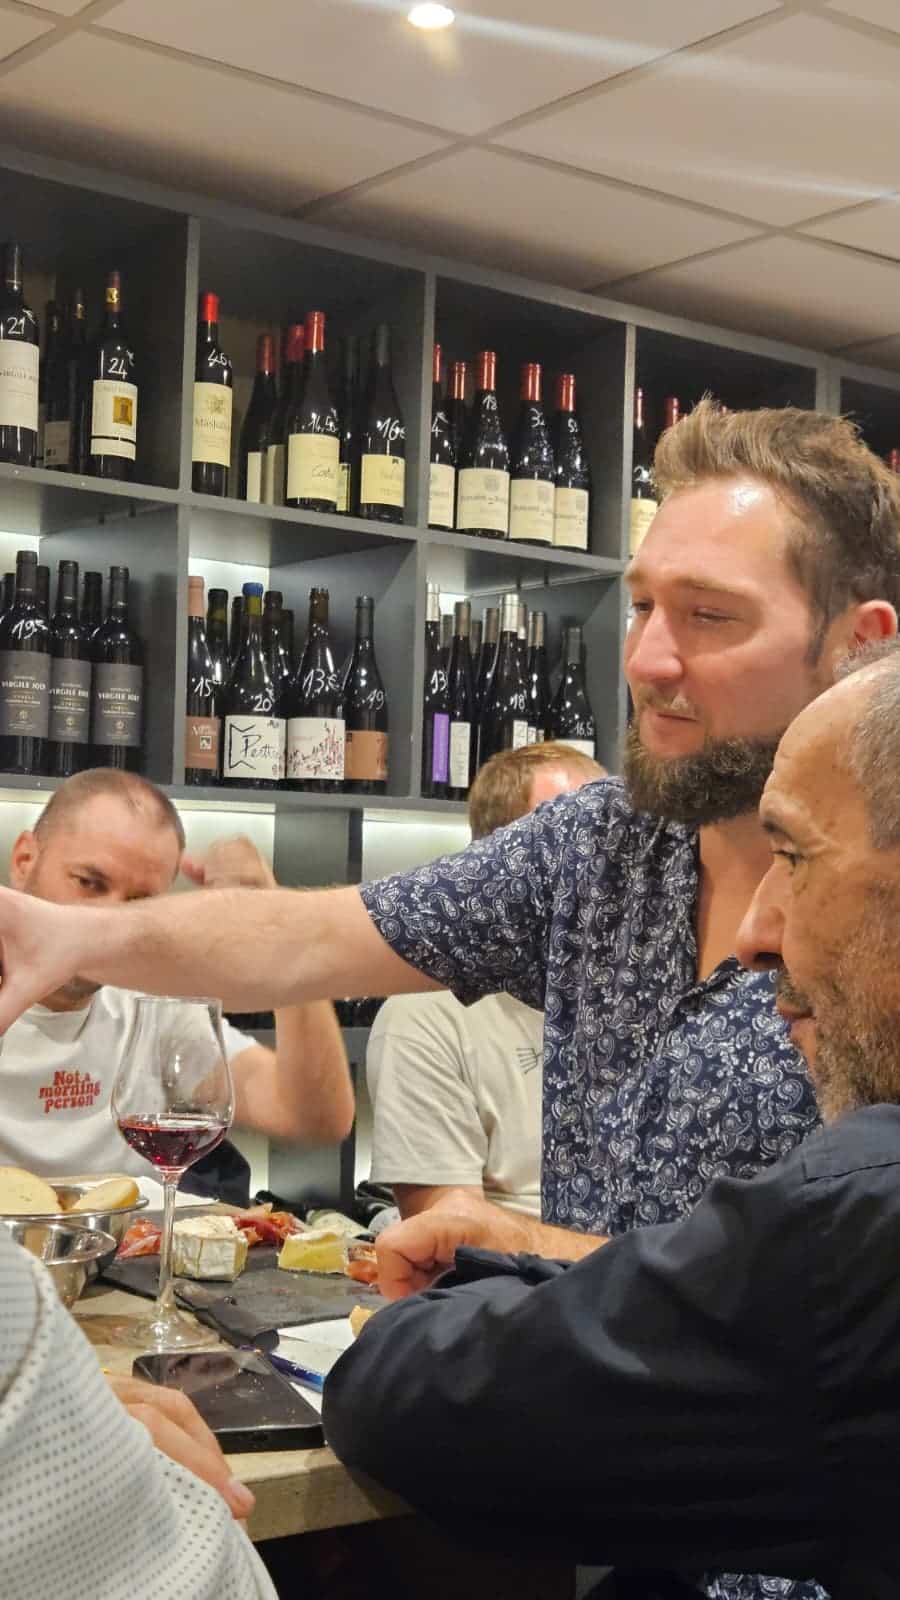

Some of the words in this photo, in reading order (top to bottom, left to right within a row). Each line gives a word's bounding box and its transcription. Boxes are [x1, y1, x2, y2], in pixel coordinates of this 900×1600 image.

[53, 1069, 81, 1086] Not
[38, 1080, 102, 1099] morning
[44, 1094, 95, 1115] person
